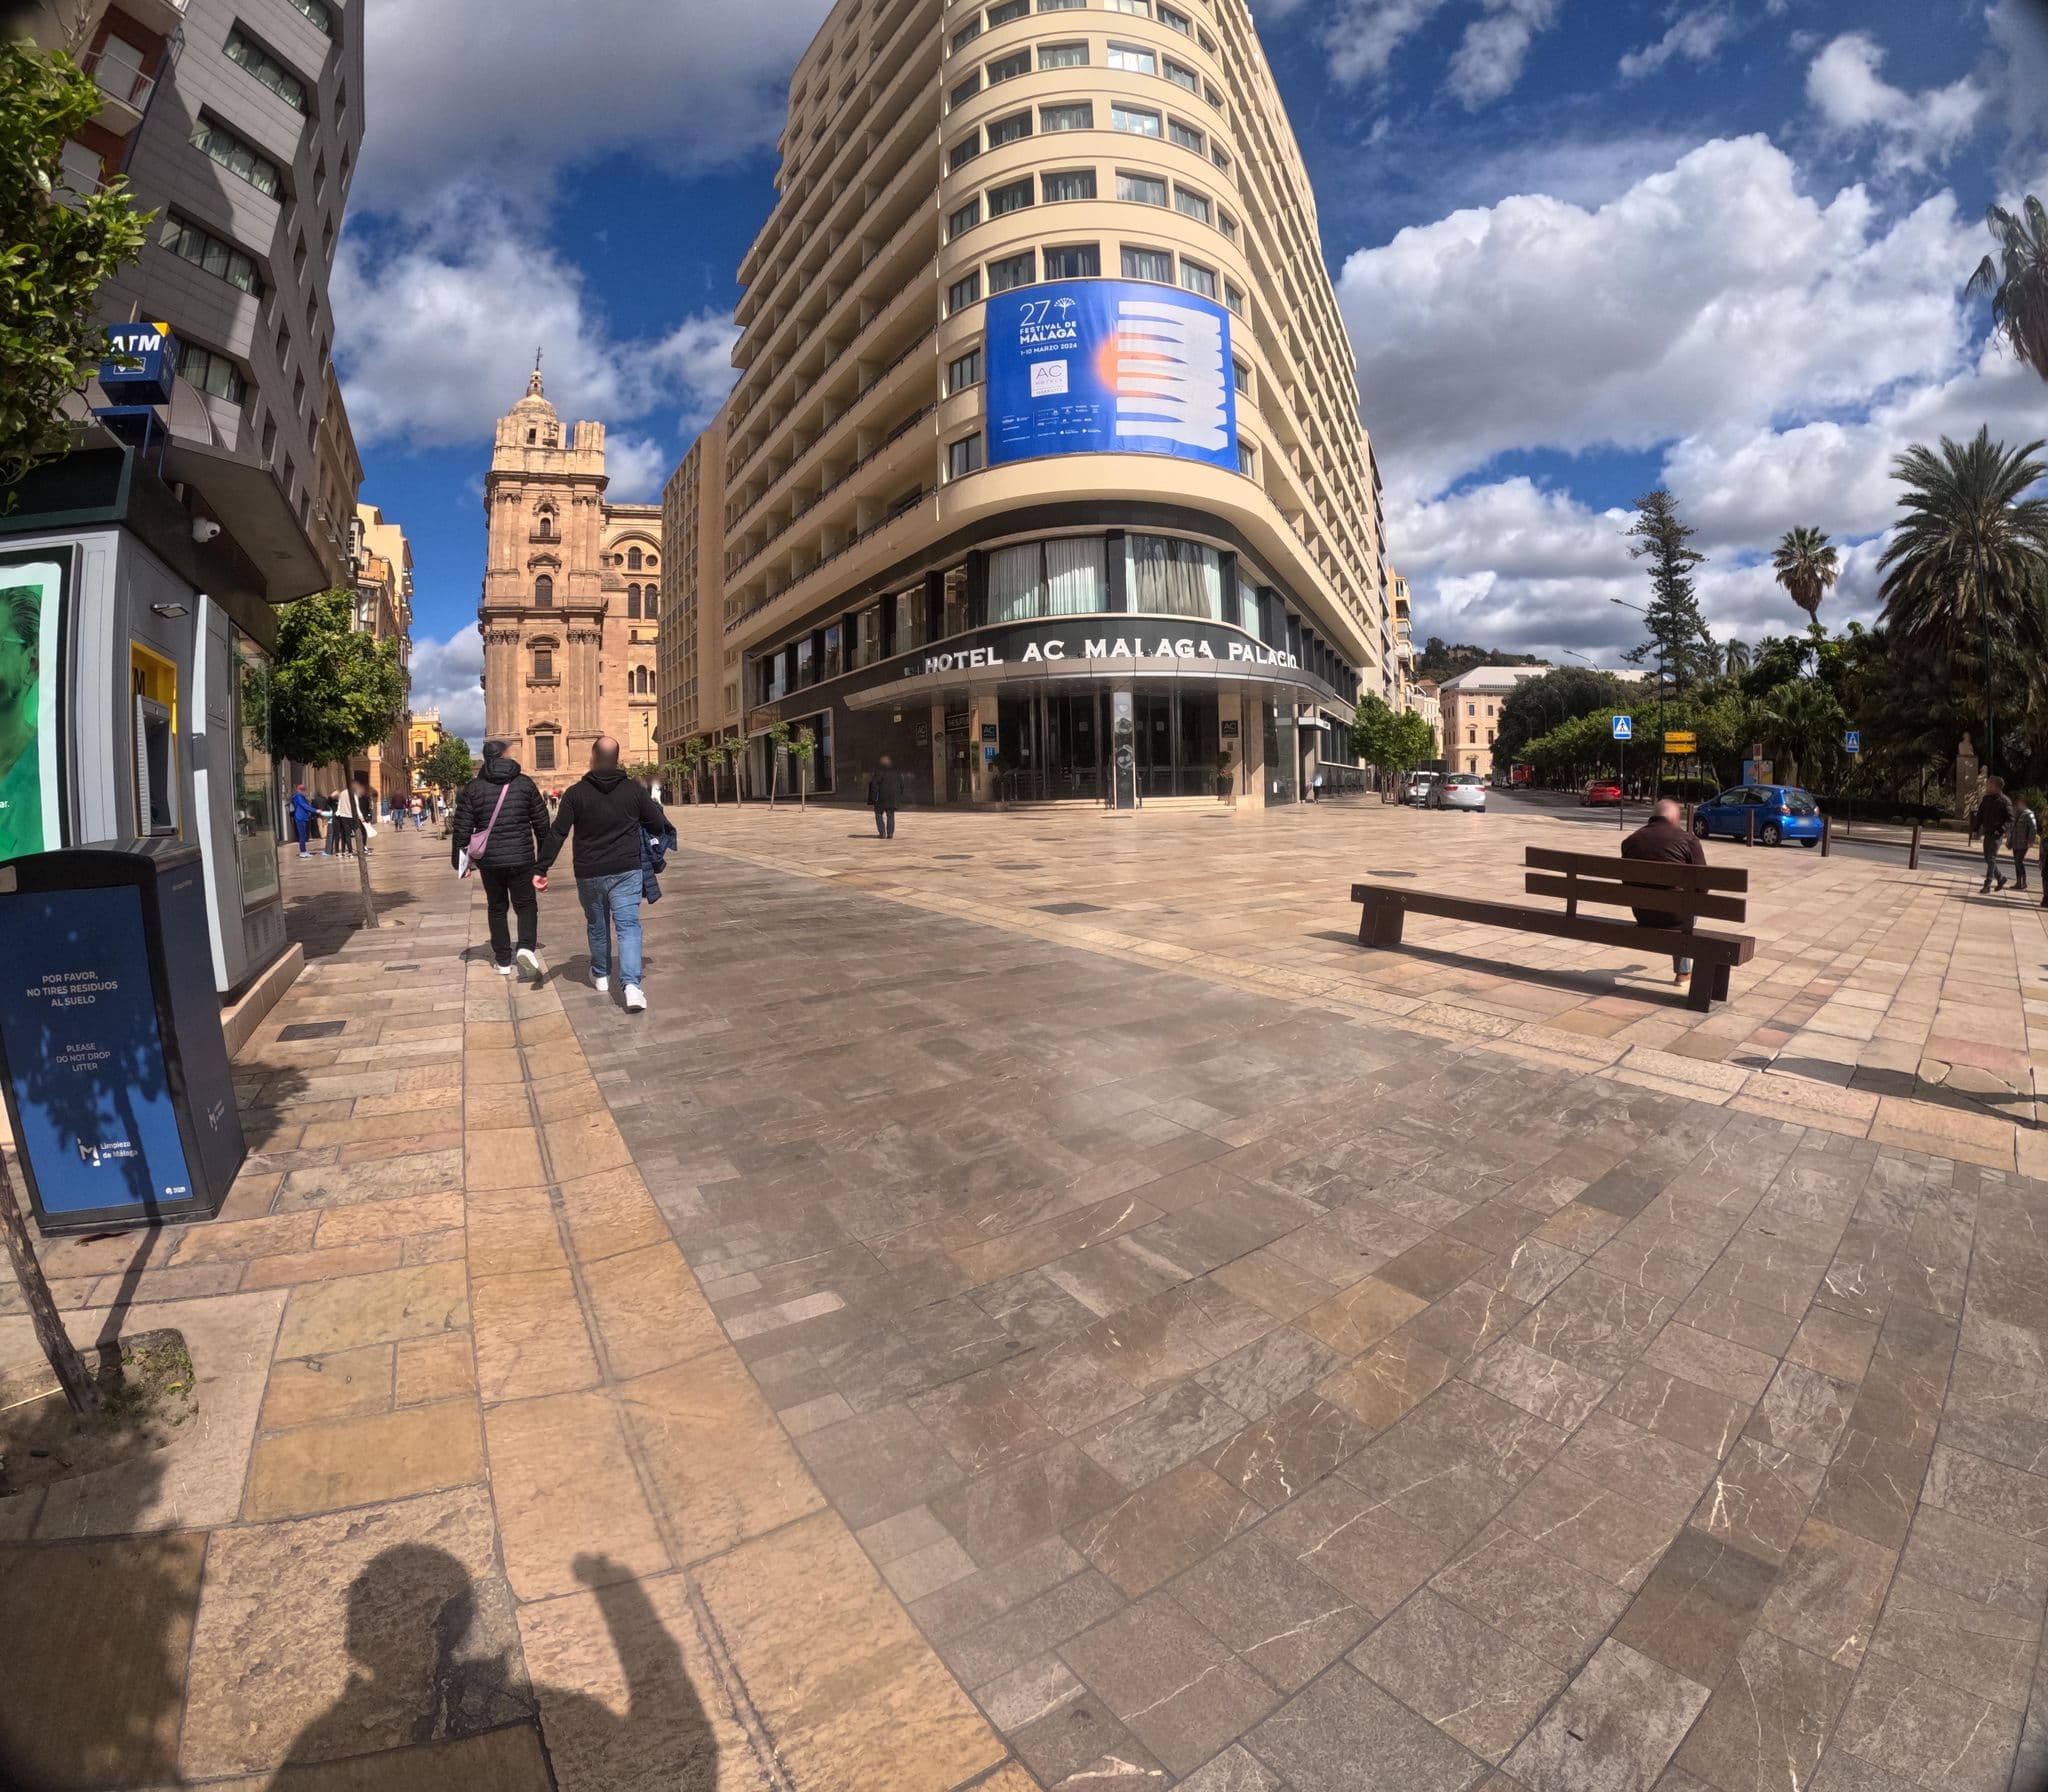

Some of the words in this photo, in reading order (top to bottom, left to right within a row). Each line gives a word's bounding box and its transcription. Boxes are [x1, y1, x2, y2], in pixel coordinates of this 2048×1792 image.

[1020, 300, 1050, 327] 27
[1020, 323, 1061, 334] FESTIVAL
[110, 334, 161, 352] ATM
[1033, 344, 1059, 353] MARZO
[1060, 342, 1078, 350] 2024
[1036, 365, 1063, 380] AC
[925, 646, 1004, 674] HOTEL
[1021, 640, 1066, 663] AC
[1085, 638, 1216, 660] MALAGA
[1228, 642, 1299, 668] PALACIO
[42, 974, 62, 984] POR
[26, 988, 40, 997] NO
[42, 985, 68, 995] TIRES
[70, 981, 118, 994] RESIDUOS
[51, 998, 64, 1007] AL
[65, 995, 95, 1006] SUELO
[66, 1042, 96, 1053] PLEASE
[56, 1055, 68, 1063] DO
[69, 1053, 86, 1062] NOT
[88, 1051, 111, 1061] DROP
[72, 1062, 98, 1072] LITTER
[100, 1141, 131, 1151] Limpieza
